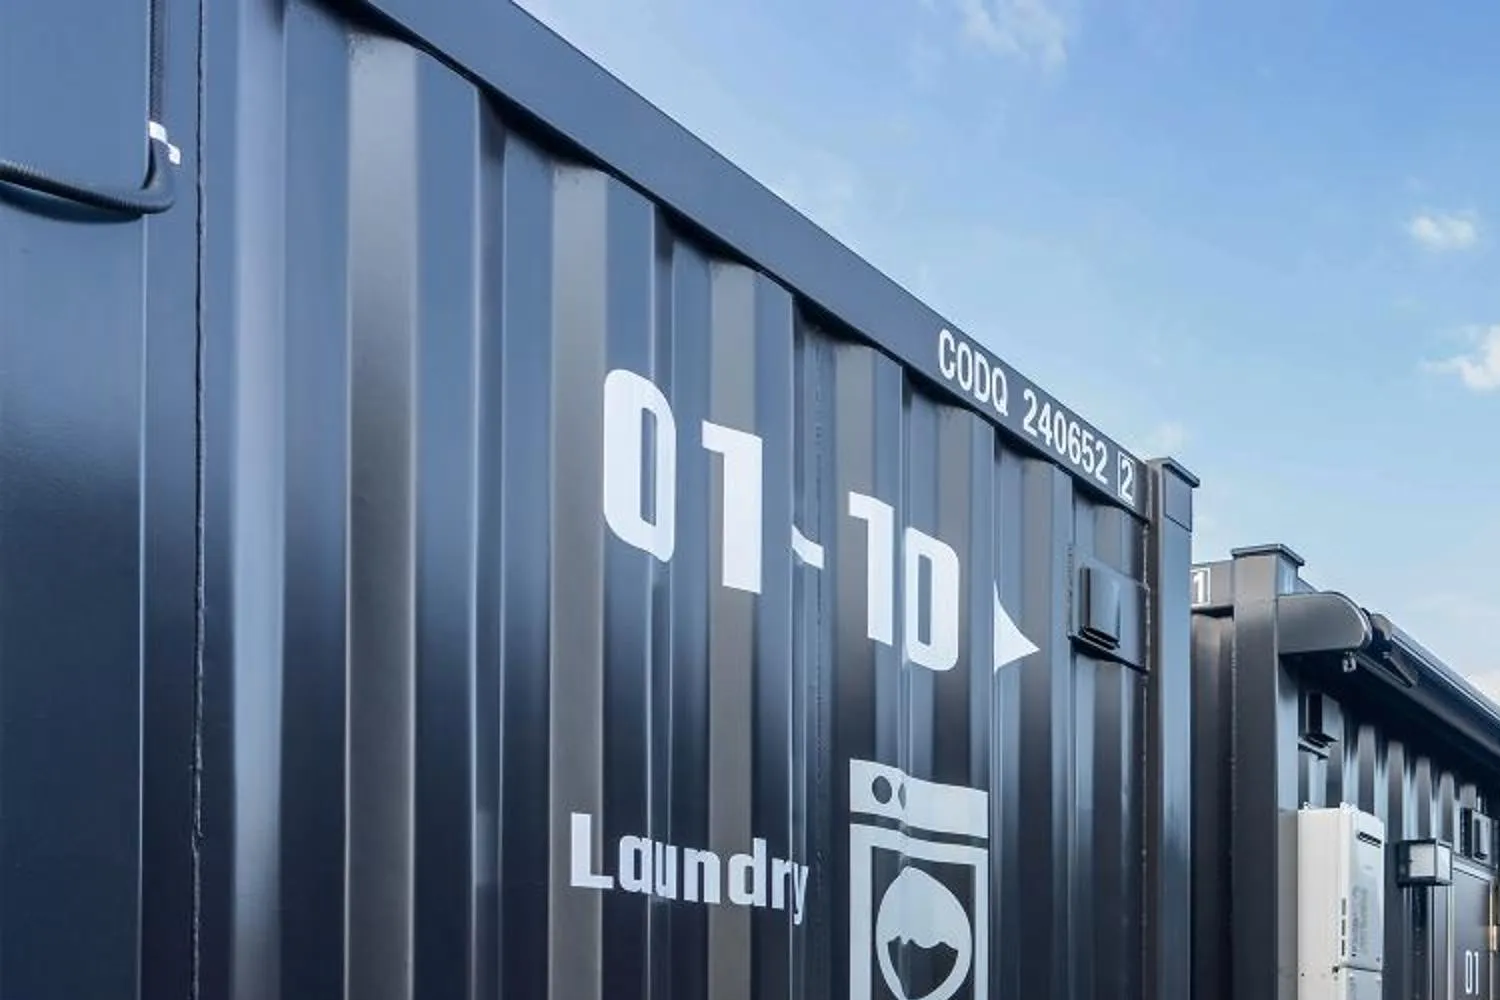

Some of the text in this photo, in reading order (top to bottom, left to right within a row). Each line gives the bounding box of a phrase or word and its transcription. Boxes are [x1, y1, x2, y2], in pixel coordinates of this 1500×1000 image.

[938, 328, 1009, 418] CODQ
[1023, 388, 1109, 486] 240652
[570, 811, 809, 926] Laundry
[1465, 949, 1479, 996] 01
